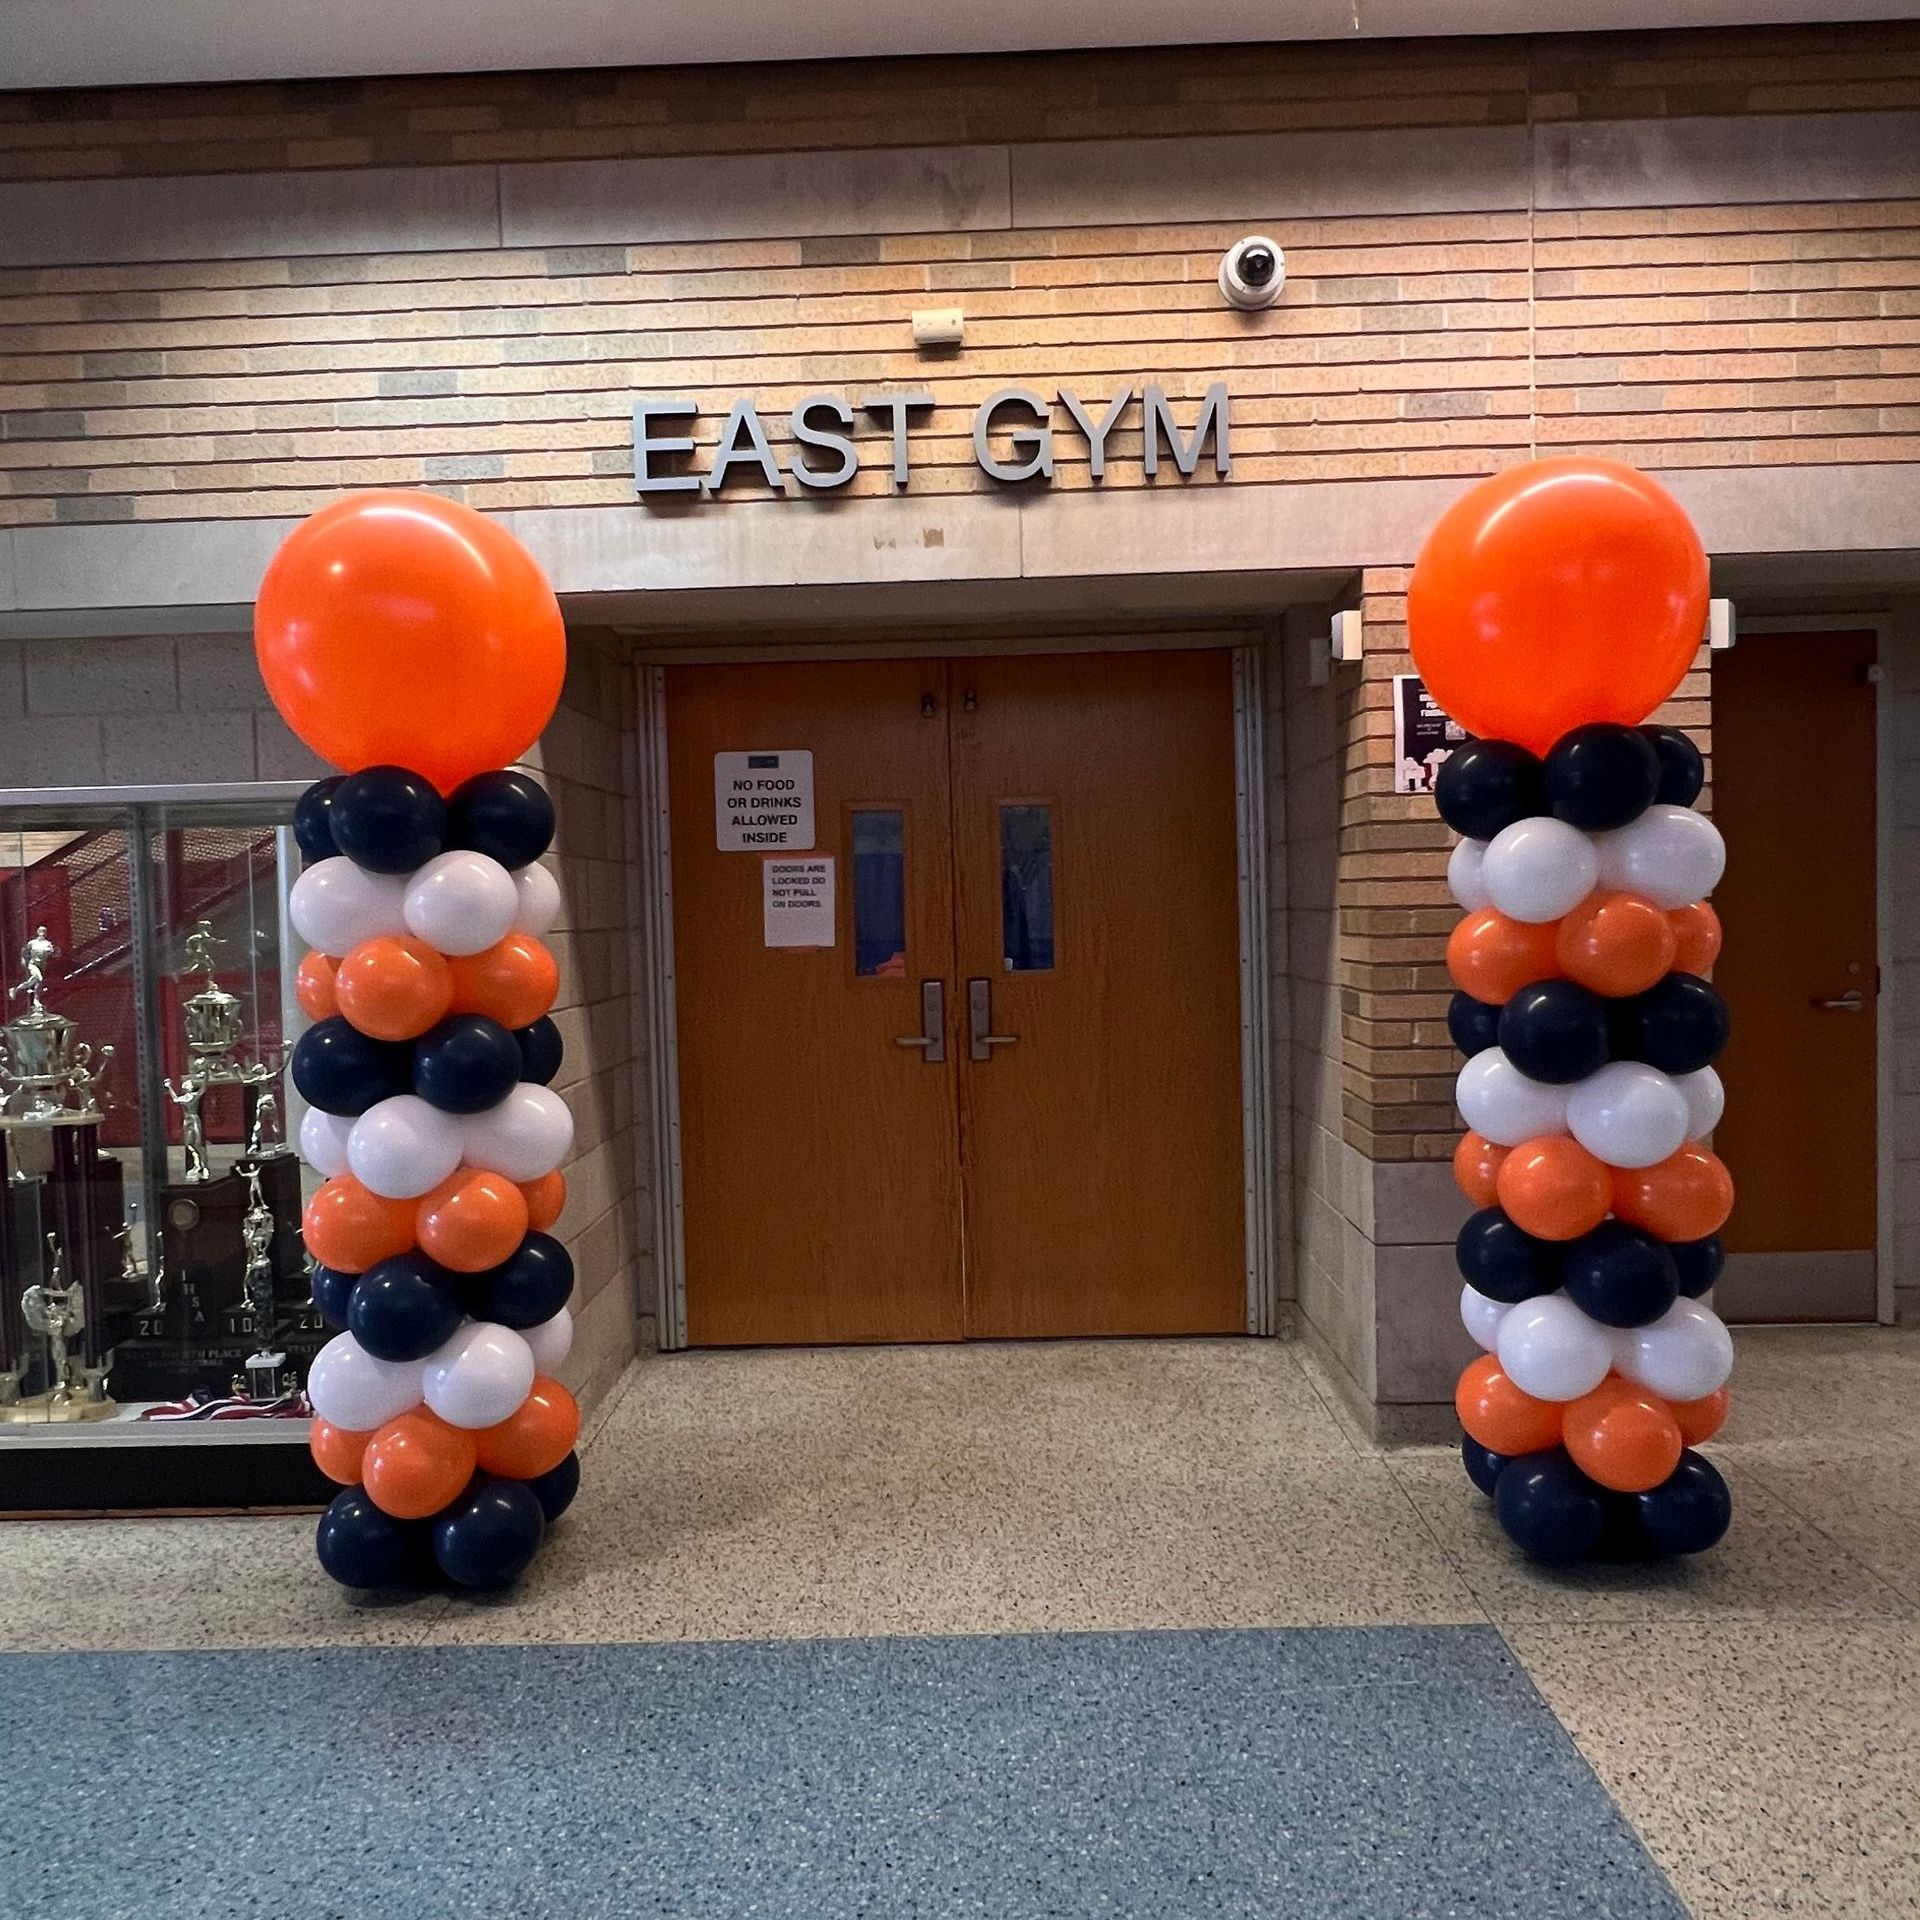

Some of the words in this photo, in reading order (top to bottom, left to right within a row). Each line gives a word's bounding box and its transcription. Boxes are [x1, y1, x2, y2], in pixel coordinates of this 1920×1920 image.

[632, 394, 935, 494] EAST
[974, 382, 1230, 480] GYM
[733, 779, 753, 791] NO
[757, 779, 795, 791] FOOD
[727, 797, 747, 808] OR
[751, 796, 802, 808] DRINKS
[731, 813, 798, 826] ALLOWED
[742, 831, 788, 843] INSIDE
[772, 865, 805, 873] DOORS
[807, 865, 826, 873] ARE
[772, 877, 810, 885] LOCKED
[812, 876, 826, 884] DO
[772, 888, 790, 896] NOT
[793, 888, 817, 896] PULL
[772, 900, 786, 908] ON
